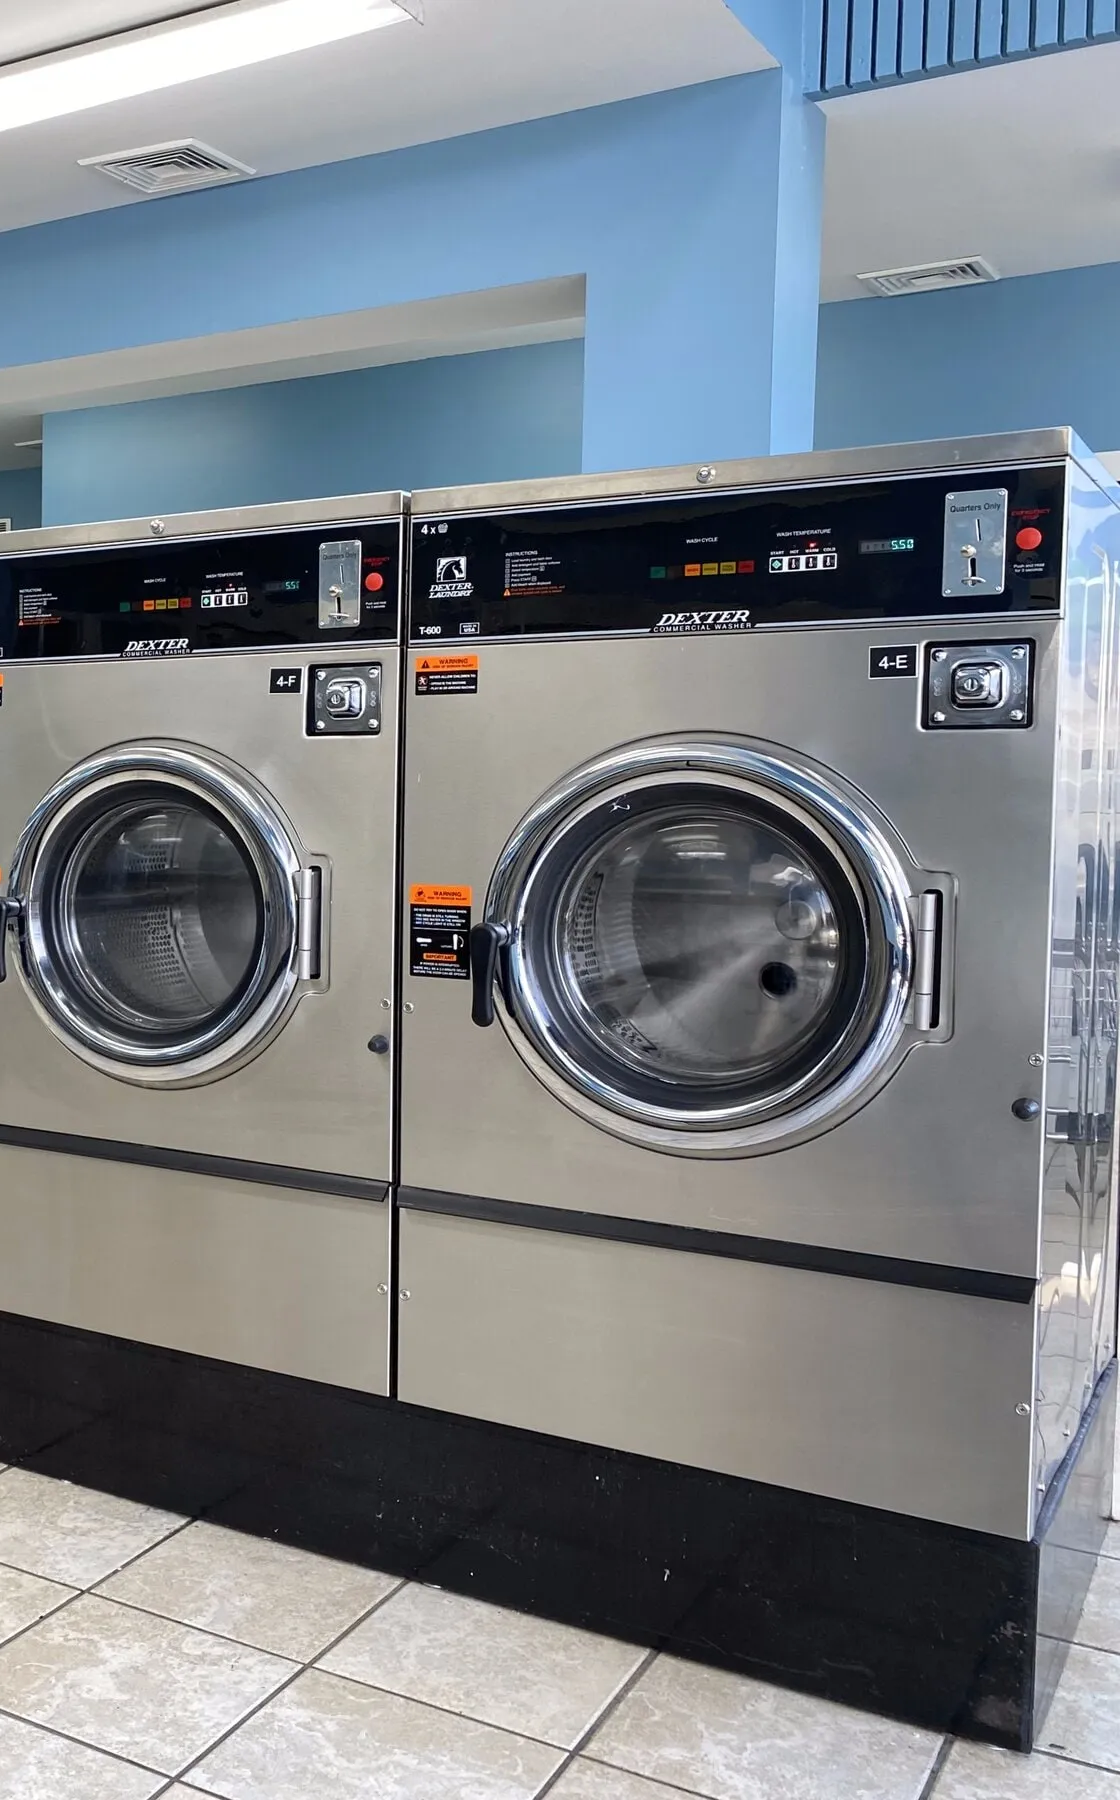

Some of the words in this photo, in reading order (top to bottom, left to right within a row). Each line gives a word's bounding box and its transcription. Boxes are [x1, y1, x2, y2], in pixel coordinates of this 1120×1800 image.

[950, 503, 982, 512] Quarters
[984, 502, 1001, 511] Only
[421, 524, 428, 534] 4
[428, 590, 473, 598] LAUNDRY
[656, 610, 750, 626] DEXTER
[419, 626, 441, 634] T-600
[653, 625, 710, 633] COMMERCIAL
[715, 622, 751, 630] WASHER
[125, 638, 189, 651] DEXTER
[878, 654, 908, 669] 4-E
[276, 676, 296, 687] 4-F
